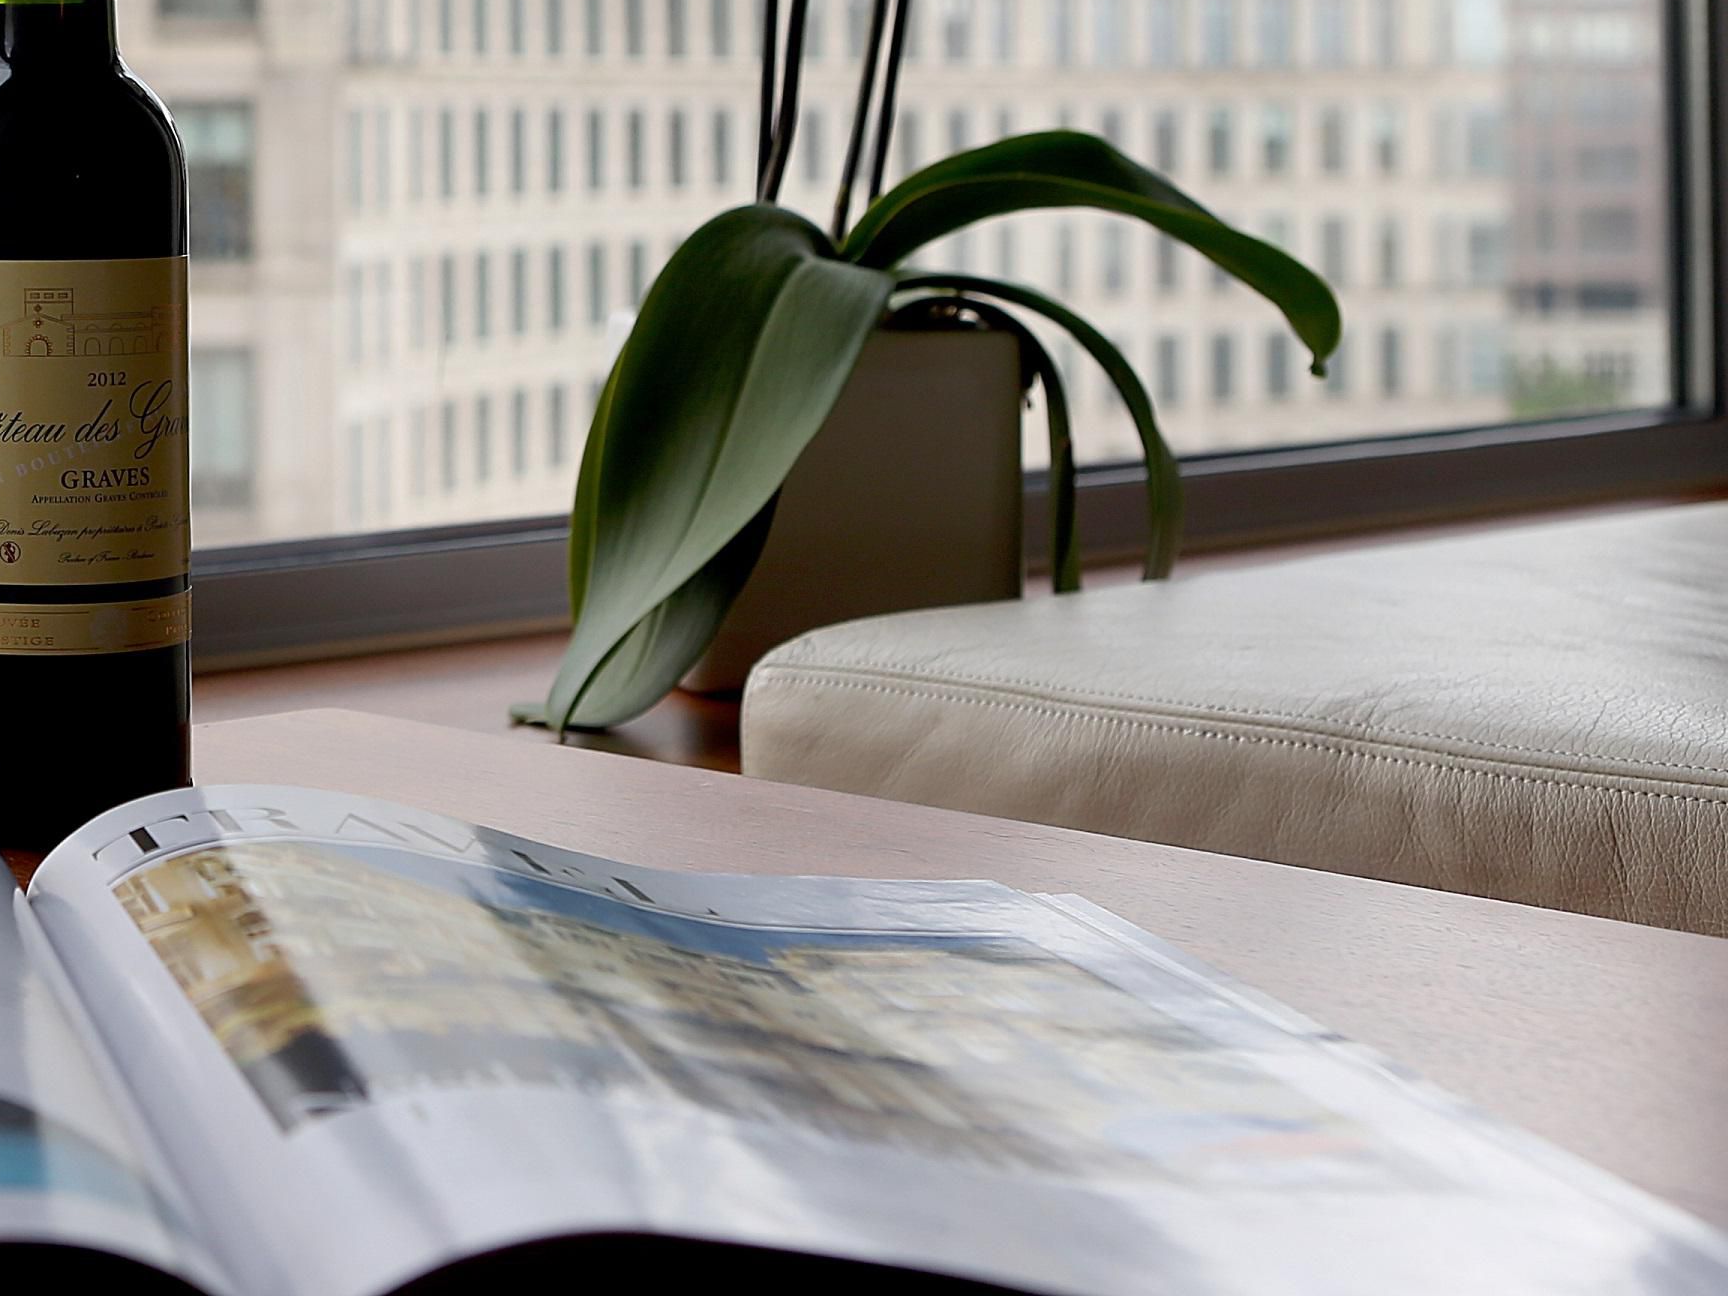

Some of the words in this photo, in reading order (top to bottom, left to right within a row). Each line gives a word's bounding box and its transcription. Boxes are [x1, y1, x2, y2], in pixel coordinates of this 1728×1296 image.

[87, 371, 127, 388] 2012
[74, 399, 121, 443] des
[60, 466, 150, 490] GRAVES
[31, 494, 91, 505] APPELLATION
[94, 493, 127, 504] GRAVES
